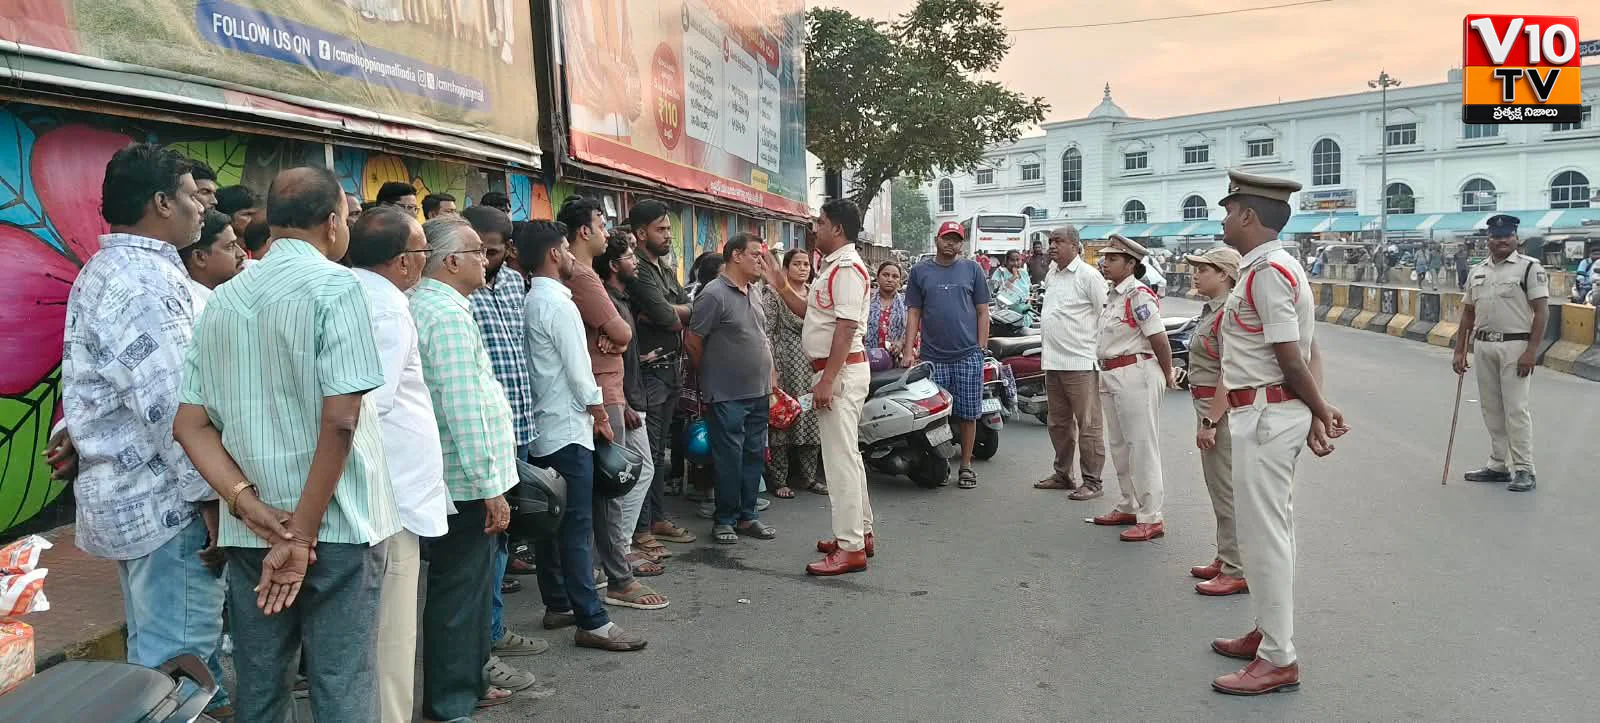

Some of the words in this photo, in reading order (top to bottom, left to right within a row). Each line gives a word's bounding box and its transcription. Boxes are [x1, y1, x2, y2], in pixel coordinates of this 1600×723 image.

[213, 12, 270, 46] FOLLOW
[273, 28, 291, 51] US
[293, 35, 311, 57] ON
